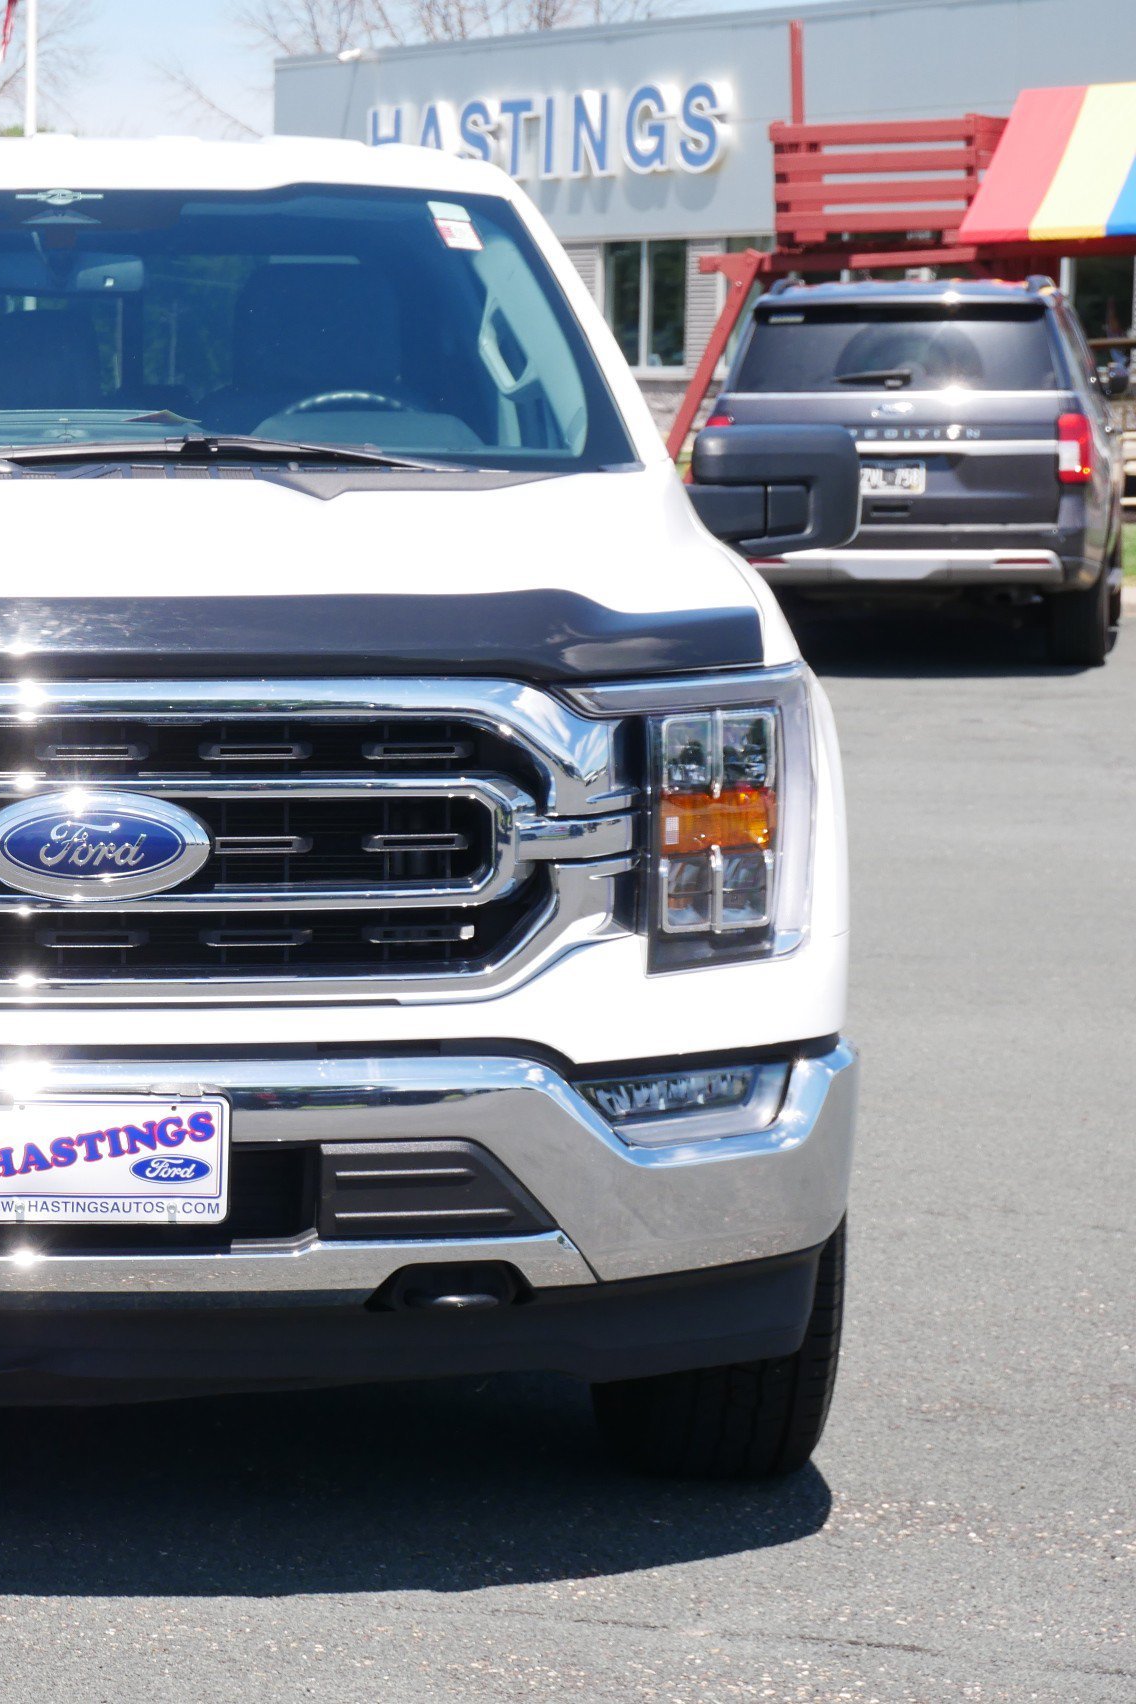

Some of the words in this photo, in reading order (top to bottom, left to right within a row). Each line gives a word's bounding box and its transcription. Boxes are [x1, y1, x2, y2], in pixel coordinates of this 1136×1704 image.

[365, 80, 730, 178] HASTINGS
[39, 821, 147, 867] Ford
[144, 1158, 196, 1179] Ford
